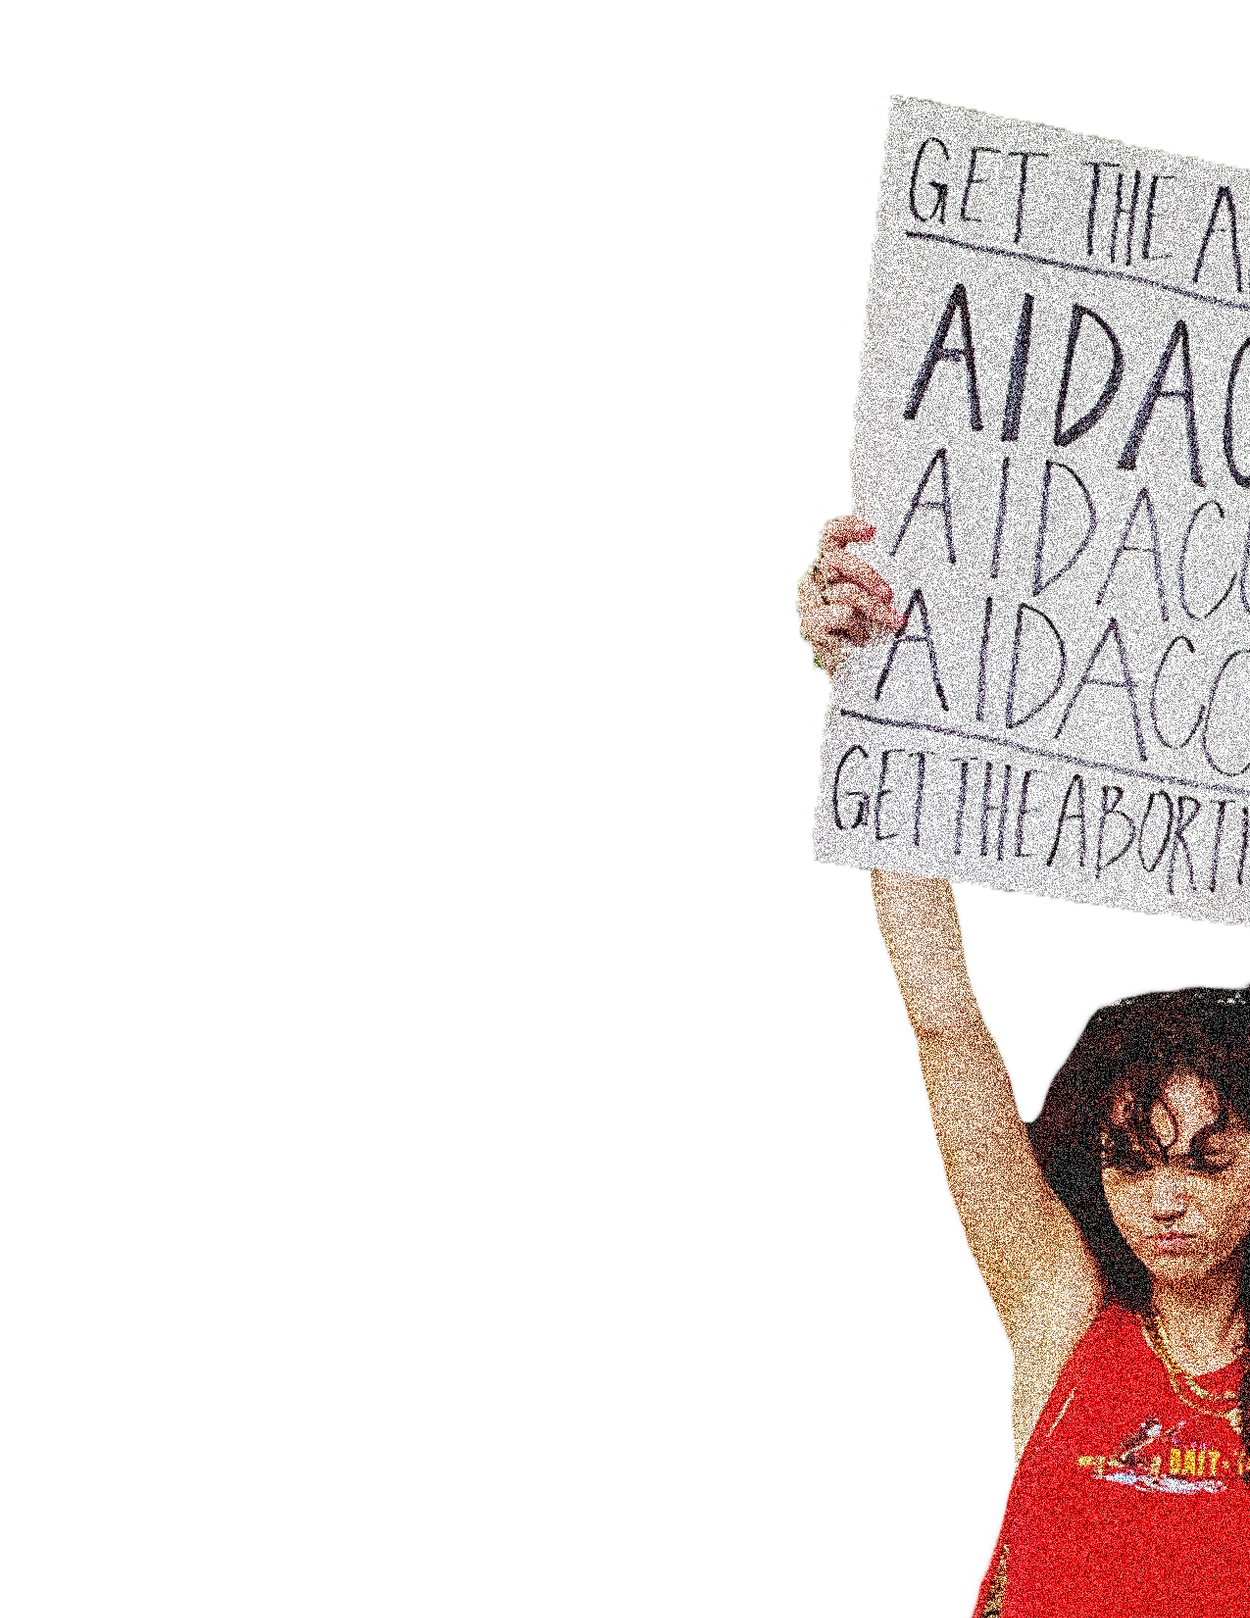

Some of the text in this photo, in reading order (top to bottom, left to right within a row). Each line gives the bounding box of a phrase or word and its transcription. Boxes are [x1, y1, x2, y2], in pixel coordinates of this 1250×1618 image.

[907, 136, 1050, 244] GET
[1081, 160, 1177, 266] THE
[831, 743, 936, 848] GET
[949, 757, 1034, 863] THE
